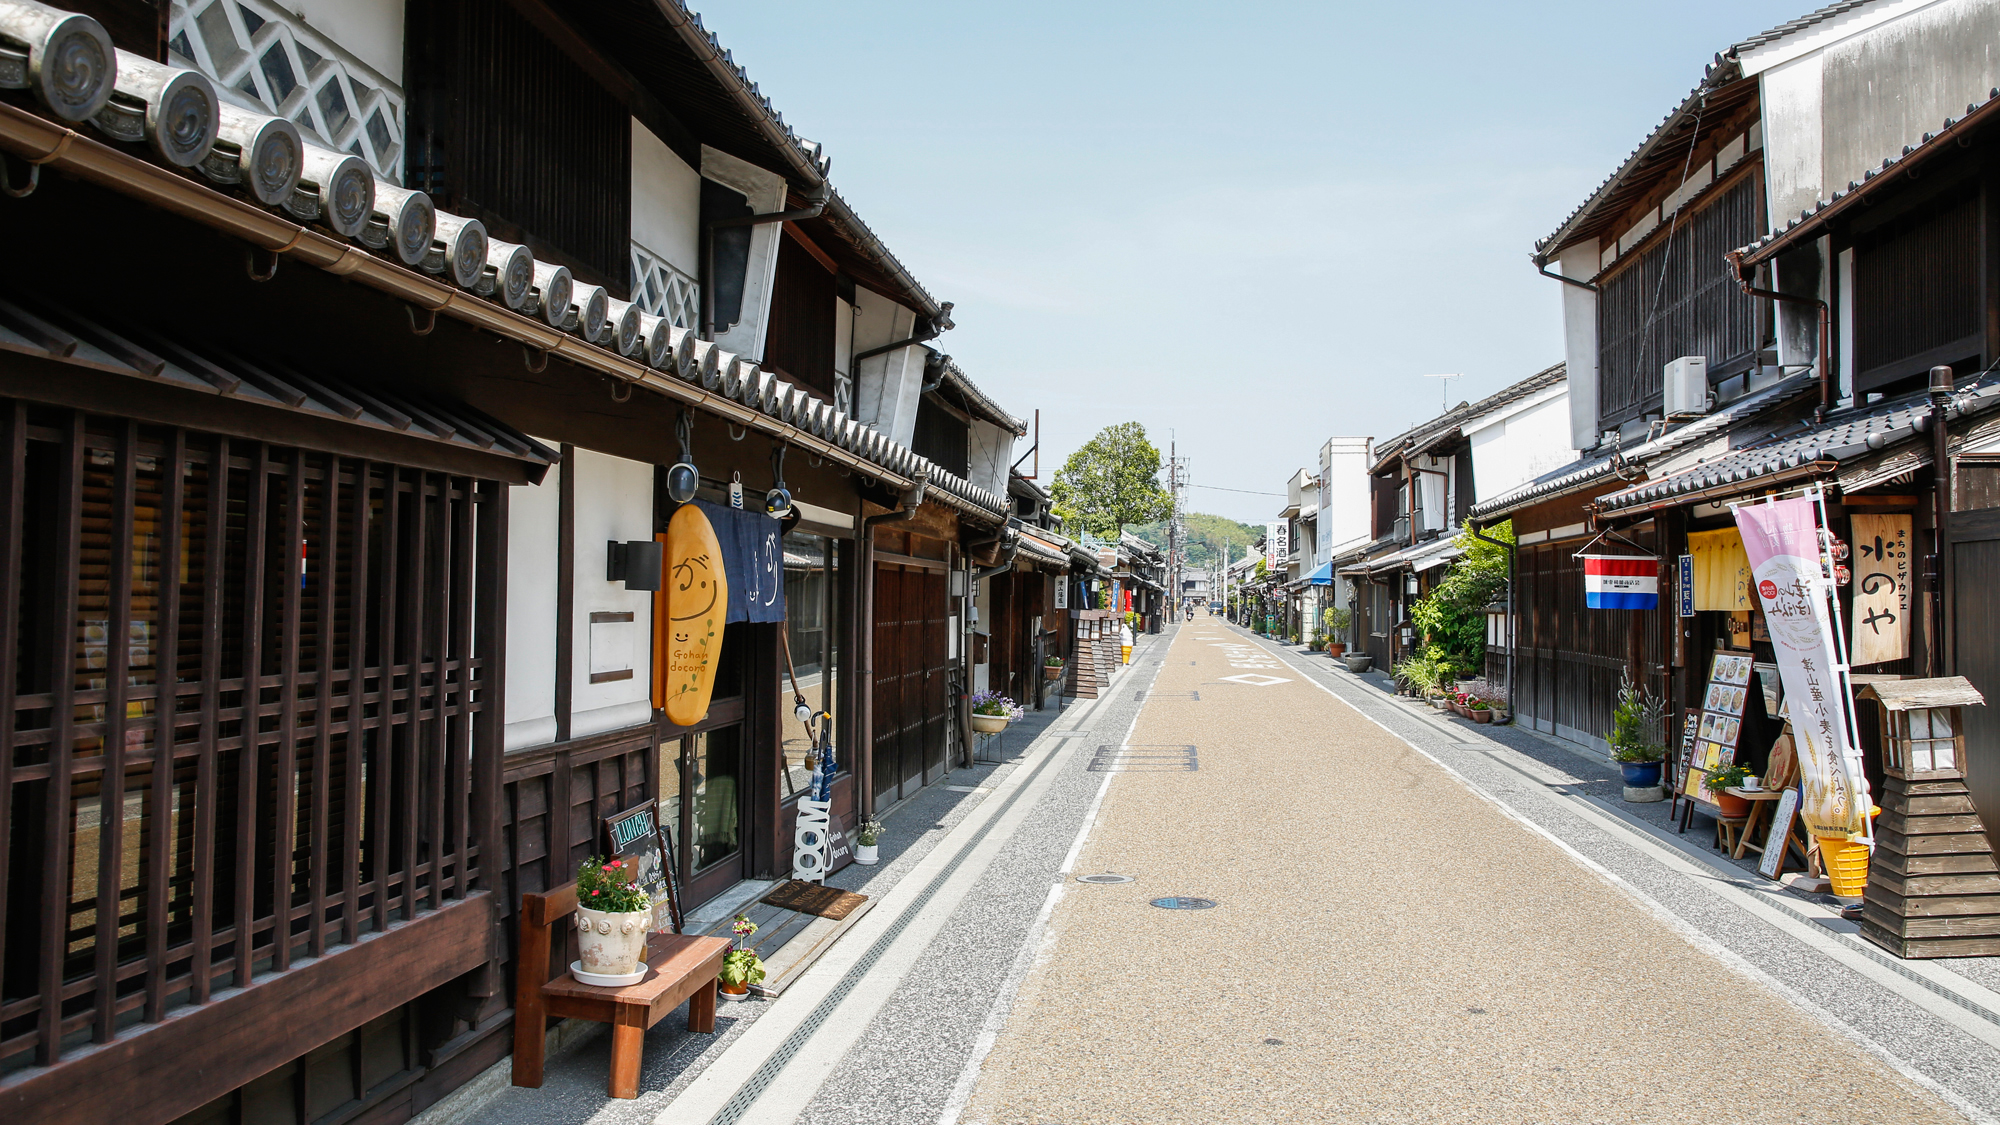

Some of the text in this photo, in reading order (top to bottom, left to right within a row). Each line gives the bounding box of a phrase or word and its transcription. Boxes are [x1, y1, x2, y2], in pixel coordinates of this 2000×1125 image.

[1896, 529, 1908, 610] まちのピザカフェ
[1727, 617, 1745, 635] Open
[673, 649, 708, 660] Gohan
[670, 661, 706, 673] docoro
[615, 812, 650, 845] LUNCH
[829, 830, 842, 844] Gohan
[832, 845, 849, 860] docoro
